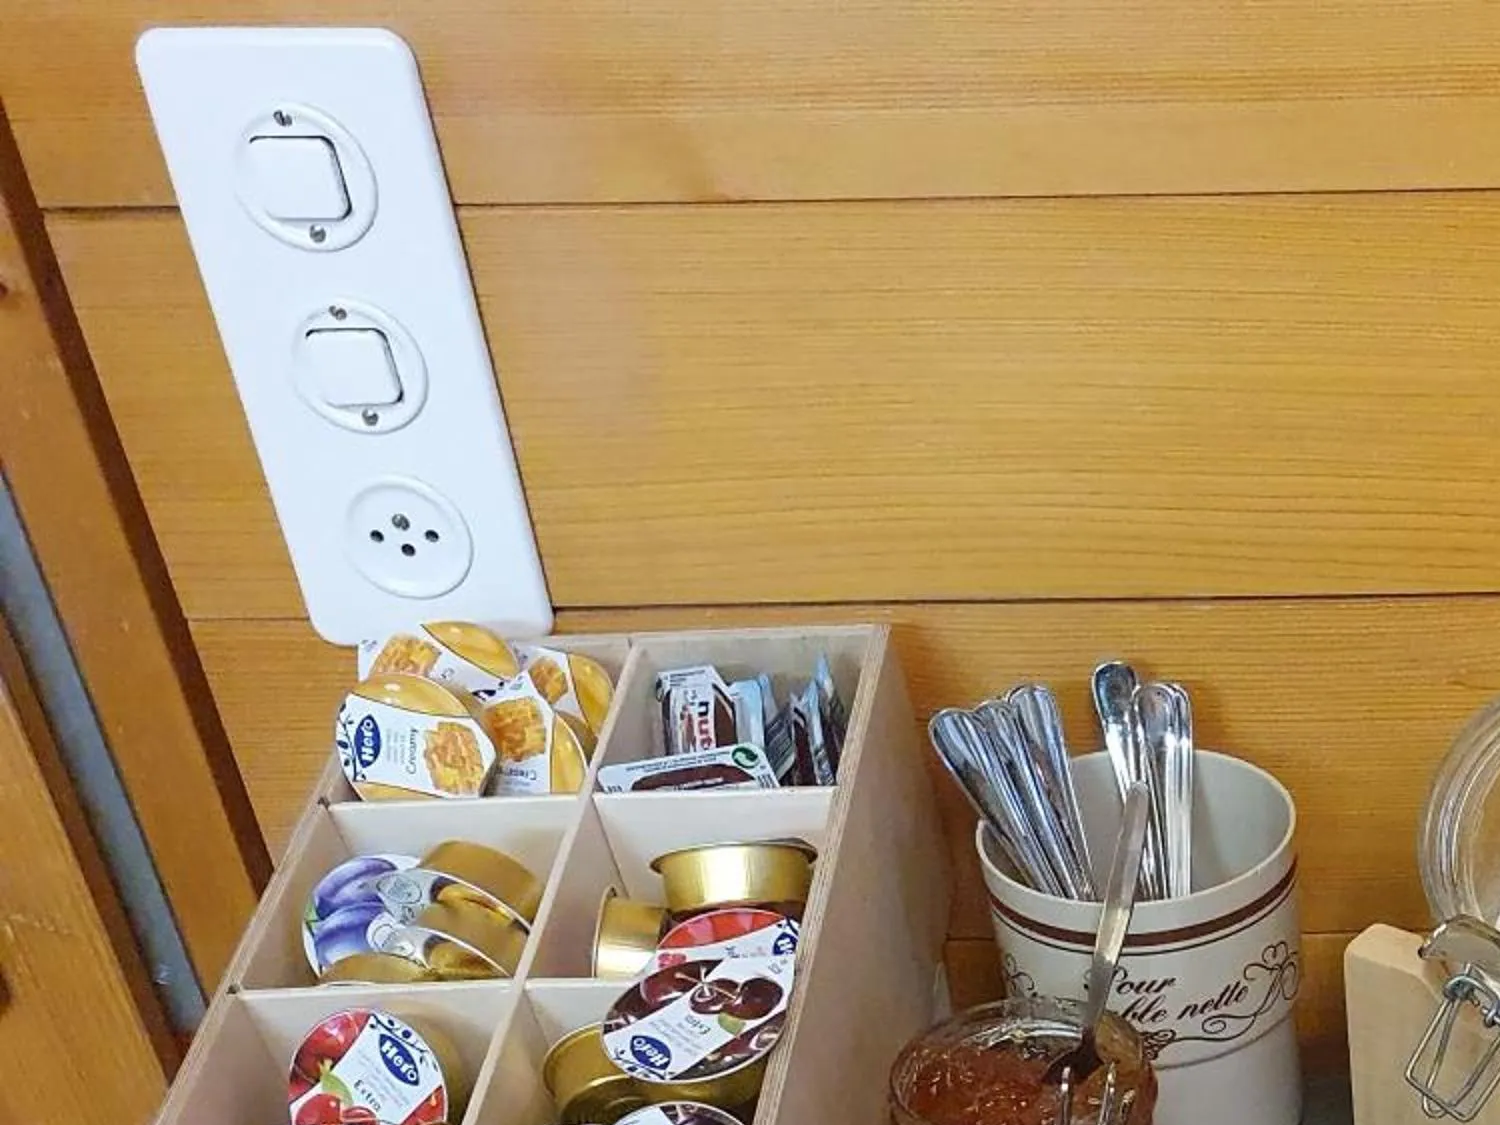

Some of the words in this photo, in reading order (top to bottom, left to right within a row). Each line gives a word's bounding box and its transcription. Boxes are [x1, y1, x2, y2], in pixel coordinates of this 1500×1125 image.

[360, 717, 376, 763] Hero
[405, 726, 419, 775] Creamy
[380, 1038, 419, 1084] Hero
[633, 1036, 669, 1069] Hero
[353, 1078, 383, 1112] Extra
